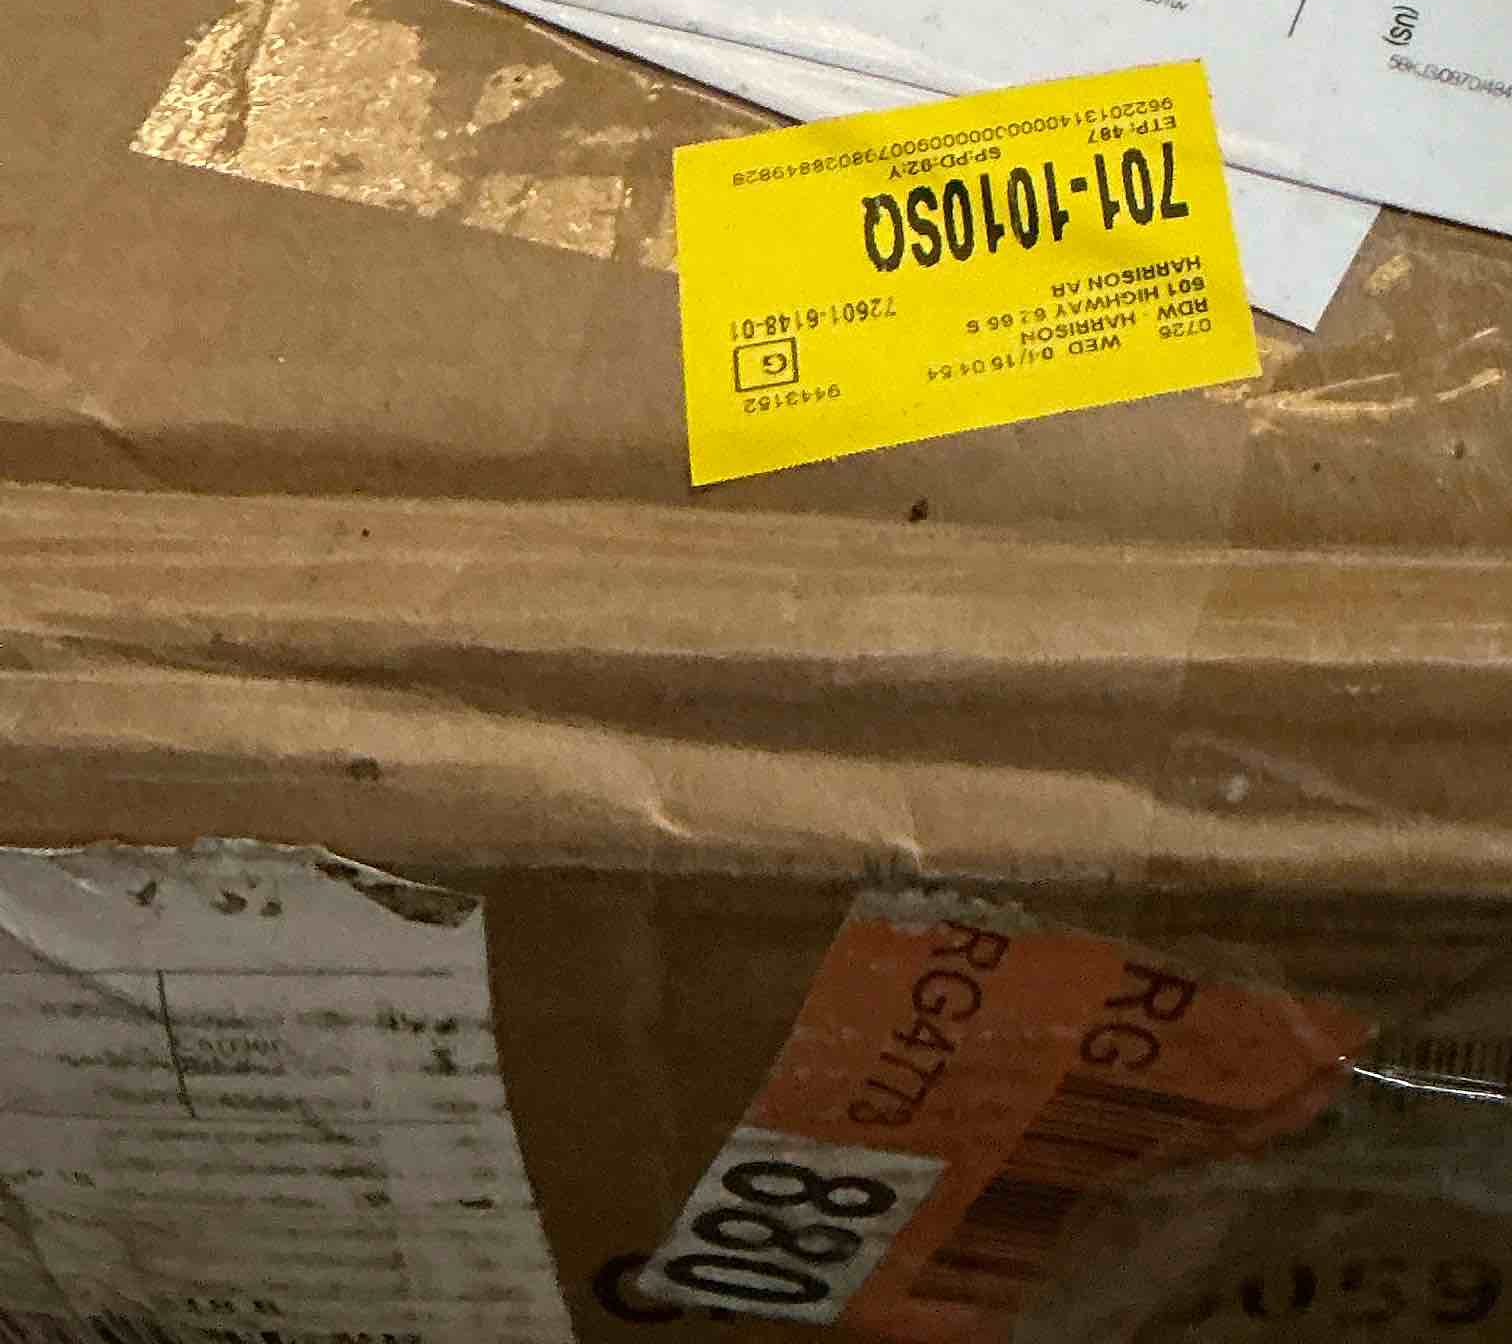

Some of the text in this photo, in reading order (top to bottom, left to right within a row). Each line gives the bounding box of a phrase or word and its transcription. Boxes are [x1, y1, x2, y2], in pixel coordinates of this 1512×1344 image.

[1381, 5, 1420, 47] (US)
[1129, 115, 1177, 137] ETP:
[861, 140, 1190, 273] 701-1010SQ
[1050, 254, 1202, 299] HARRISON AR
[1167, 276, 1206, 298] 601
[730, 295, 897, 342] 72601-6148-01
[1054, 284, 1161, 319] HIGHWAY
[1156, 296, 1209, 321] RDW
[1020, 310, 1137, 346] HARRISON
[1067, 333, 1123, 356] WED
[761, 352, 790, 377] G
[1078, 959, 1202, 1076] RG
[663, 1160, 897, 1305] 880
